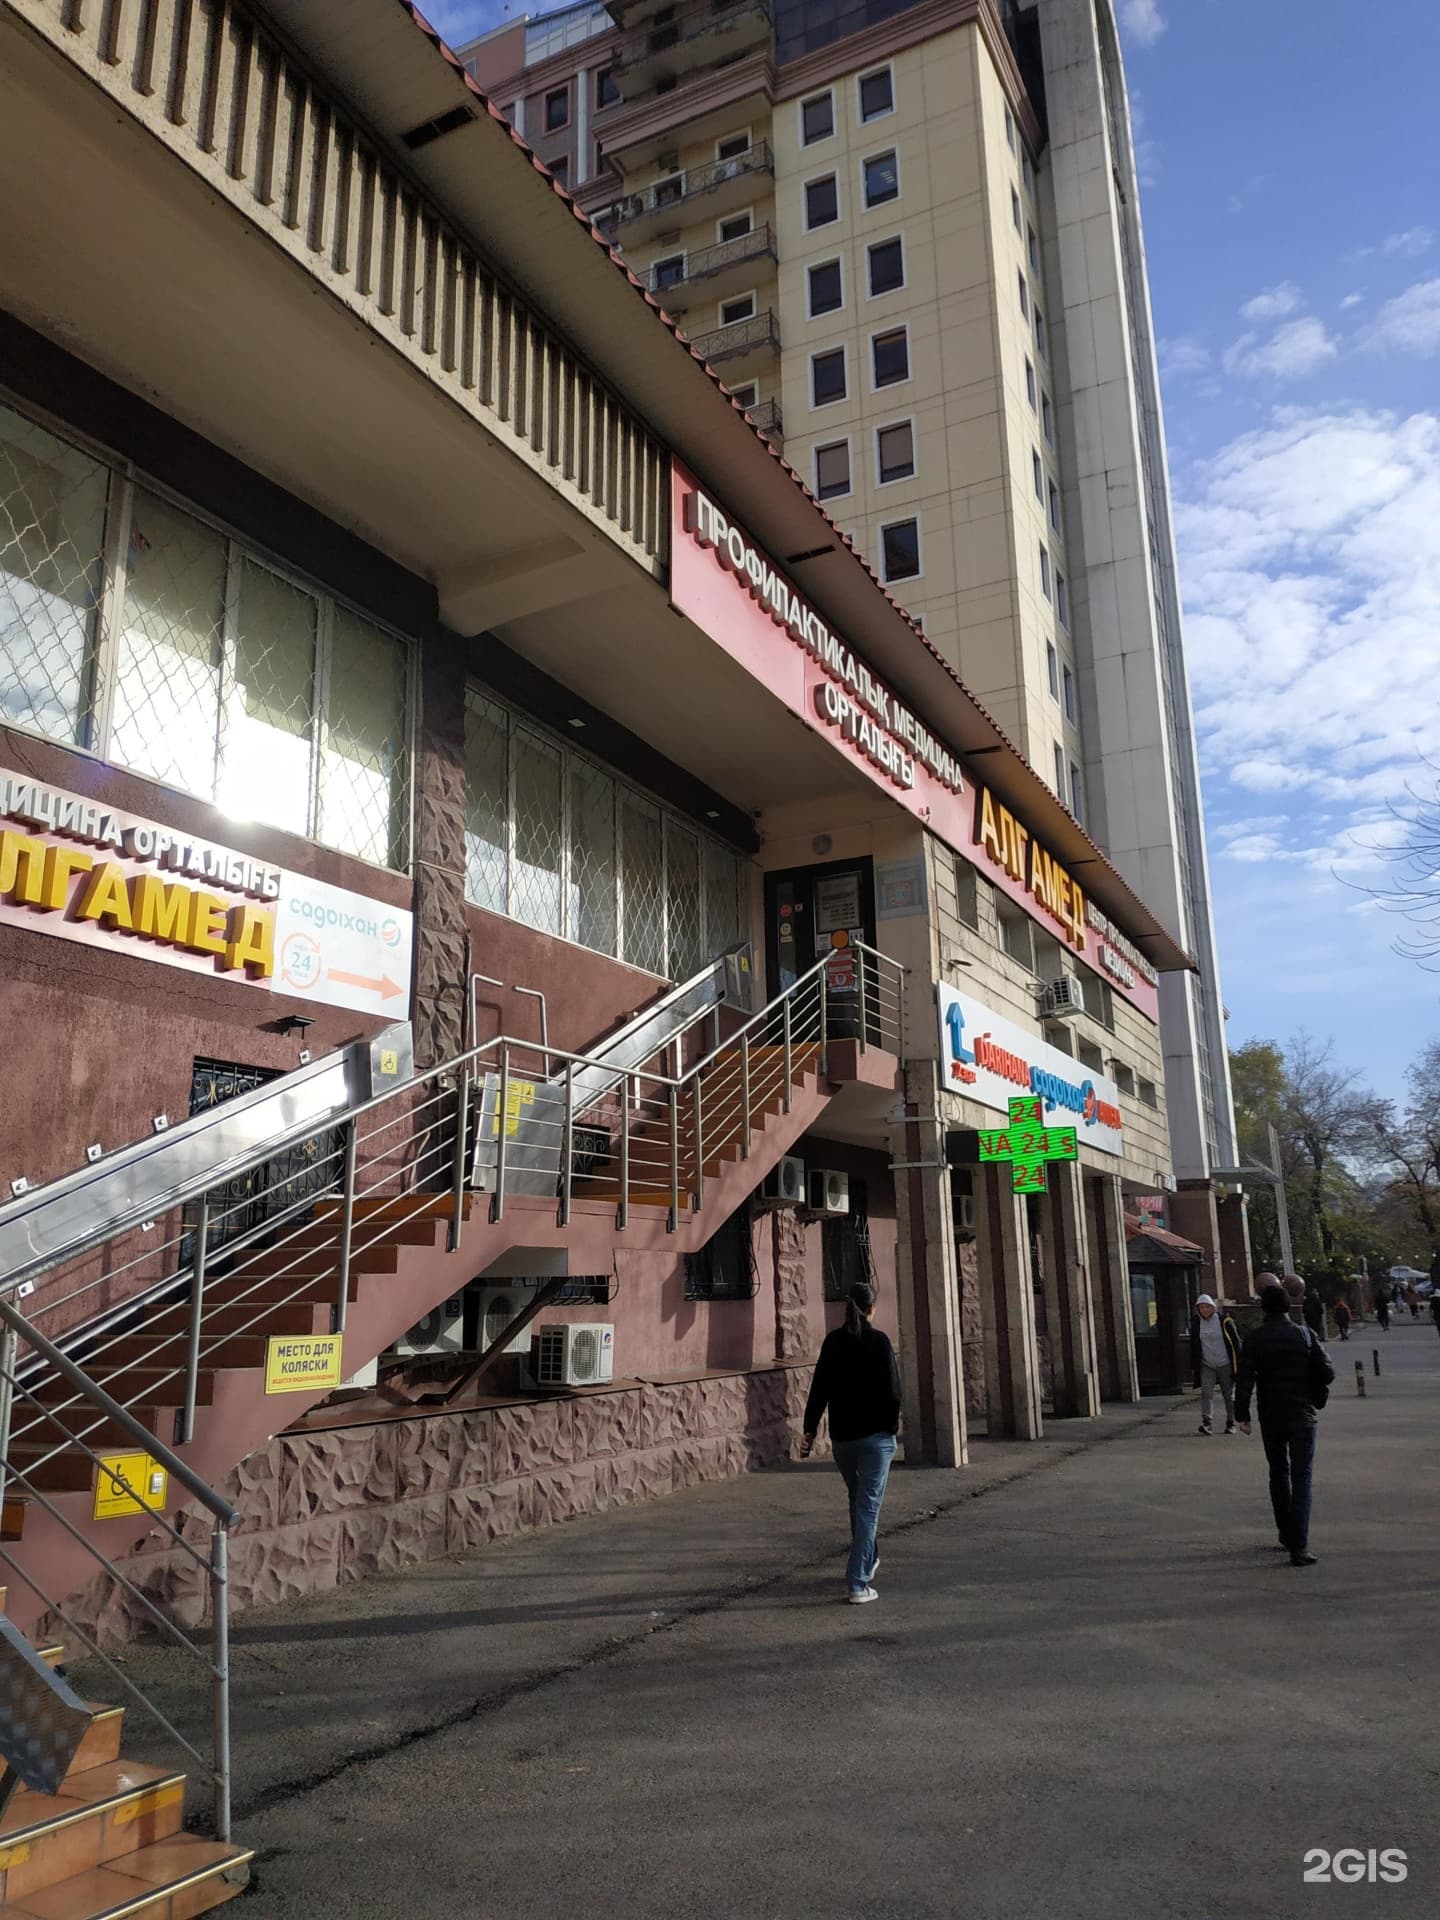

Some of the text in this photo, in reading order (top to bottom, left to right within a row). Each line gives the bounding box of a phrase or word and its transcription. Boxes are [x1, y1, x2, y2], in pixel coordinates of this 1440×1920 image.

[824, 681, 916, 789] ОРТАЛЫҒЫ
[893, 700, 964, 794] МЕДИЦИНА
[978, 784, 1087, 950] АЛГАМЕД
[289, 897, 377, 937] садыхан
[291, 951, 311, 971] 24
[1010, 1102, 1041, 1123] 24
[1022, 1132, 1049, 1153] 24
[1013, 1165, 1044, 1187] 24
[278, 1343, 334, 1357] МЕСТО ДЛЯ
[282, 1359, 328, 1374] КОЛЯСКИ
